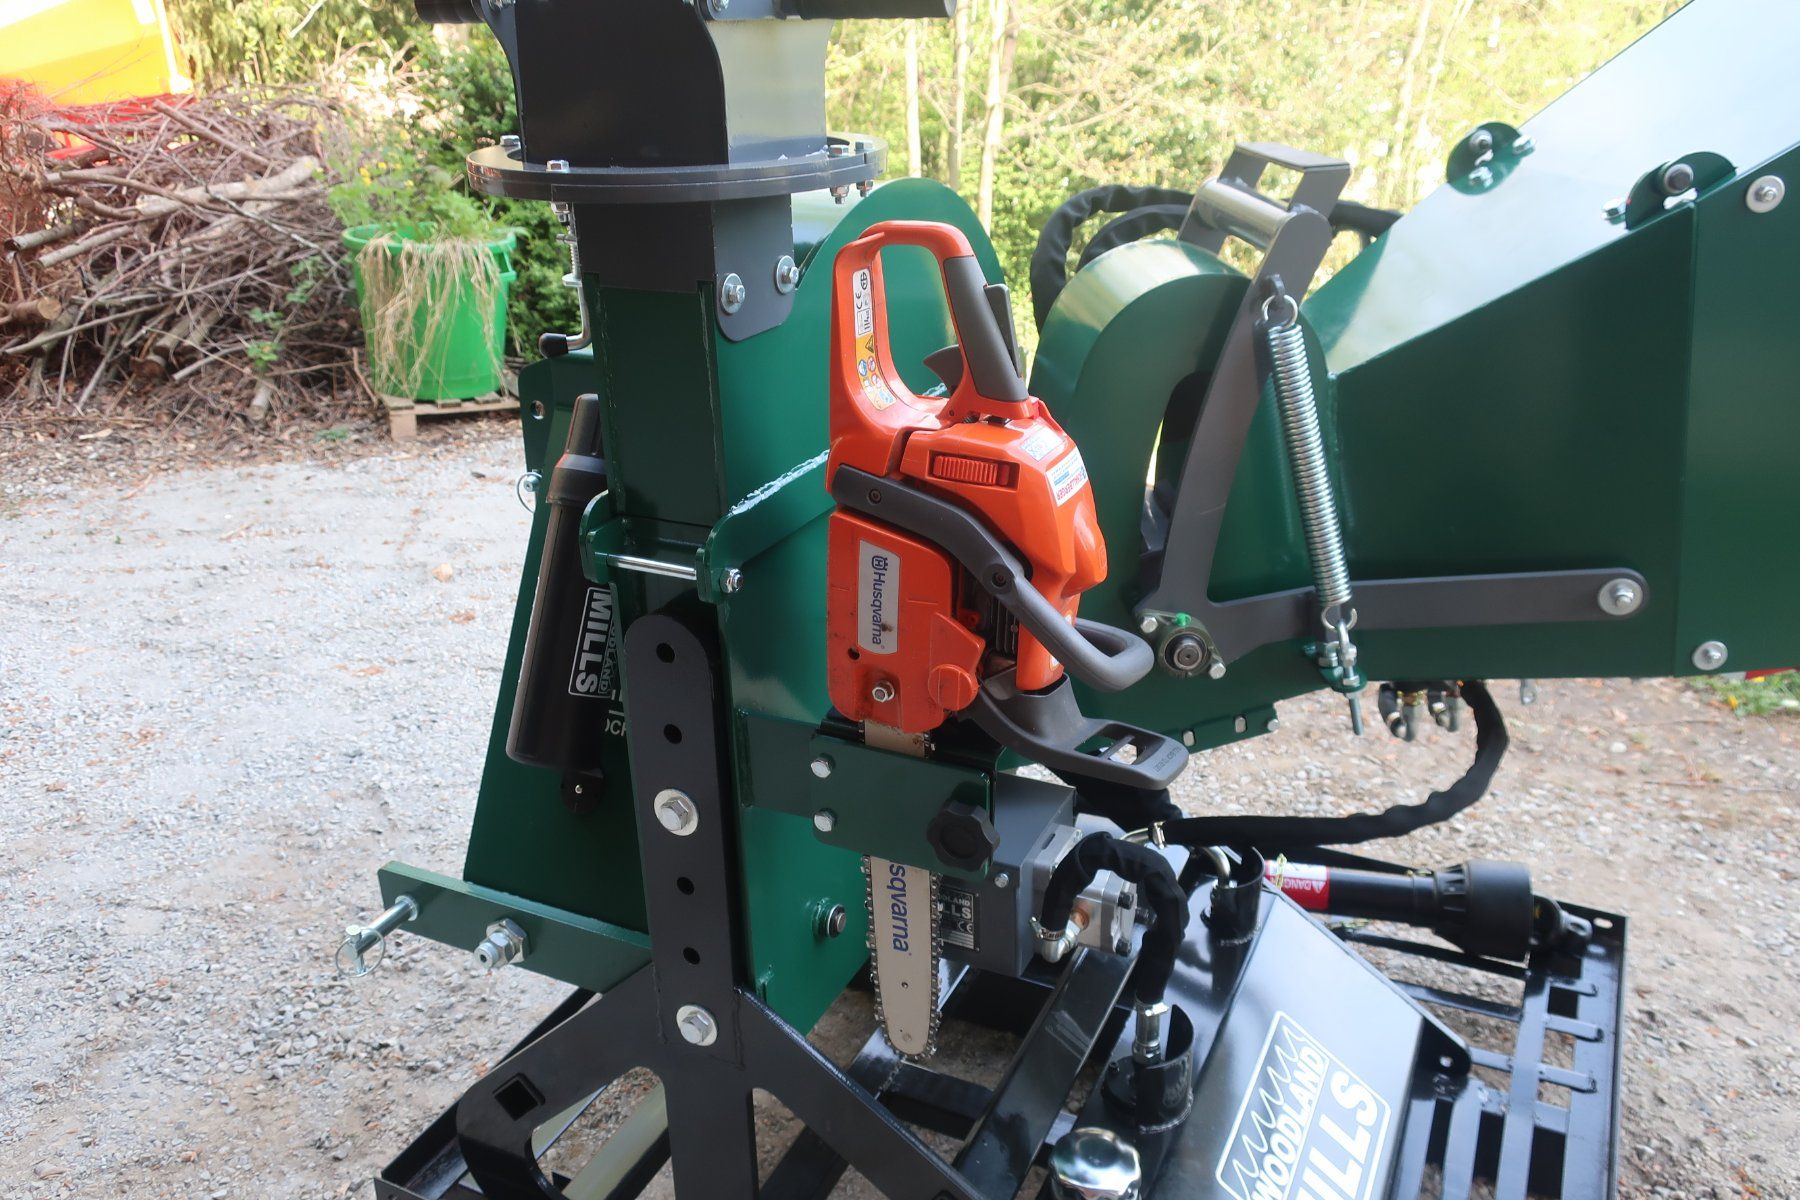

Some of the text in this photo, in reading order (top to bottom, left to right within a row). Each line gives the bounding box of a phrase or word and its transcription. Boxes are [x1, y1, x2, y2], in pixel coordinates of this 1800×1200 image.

[575, 592, 612, 693] MILLS
[870, 571, 886, 645] Husqvarna
[886, 863, 909, 952] sqvarna
